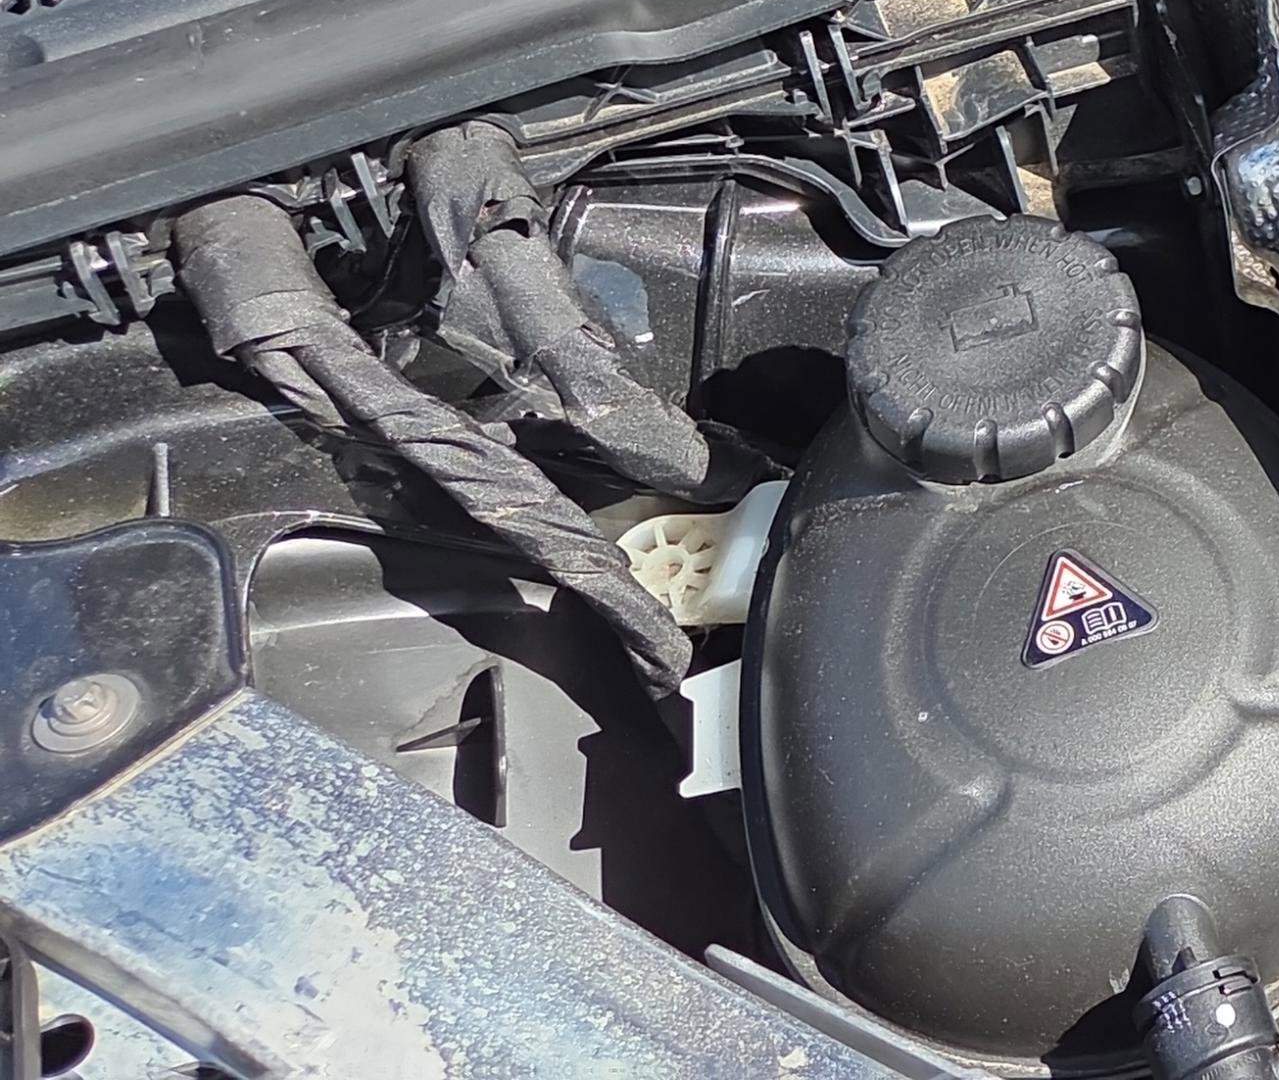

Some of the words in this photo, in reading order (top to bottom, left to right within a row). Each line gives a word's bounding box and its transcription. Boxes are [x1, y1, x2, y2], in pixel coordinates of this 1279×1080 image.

[995, 233, 1058, 259] WHEN
[1055, 252, 1094, 292] HOT
[888, 353, 937, 400] NICHT
